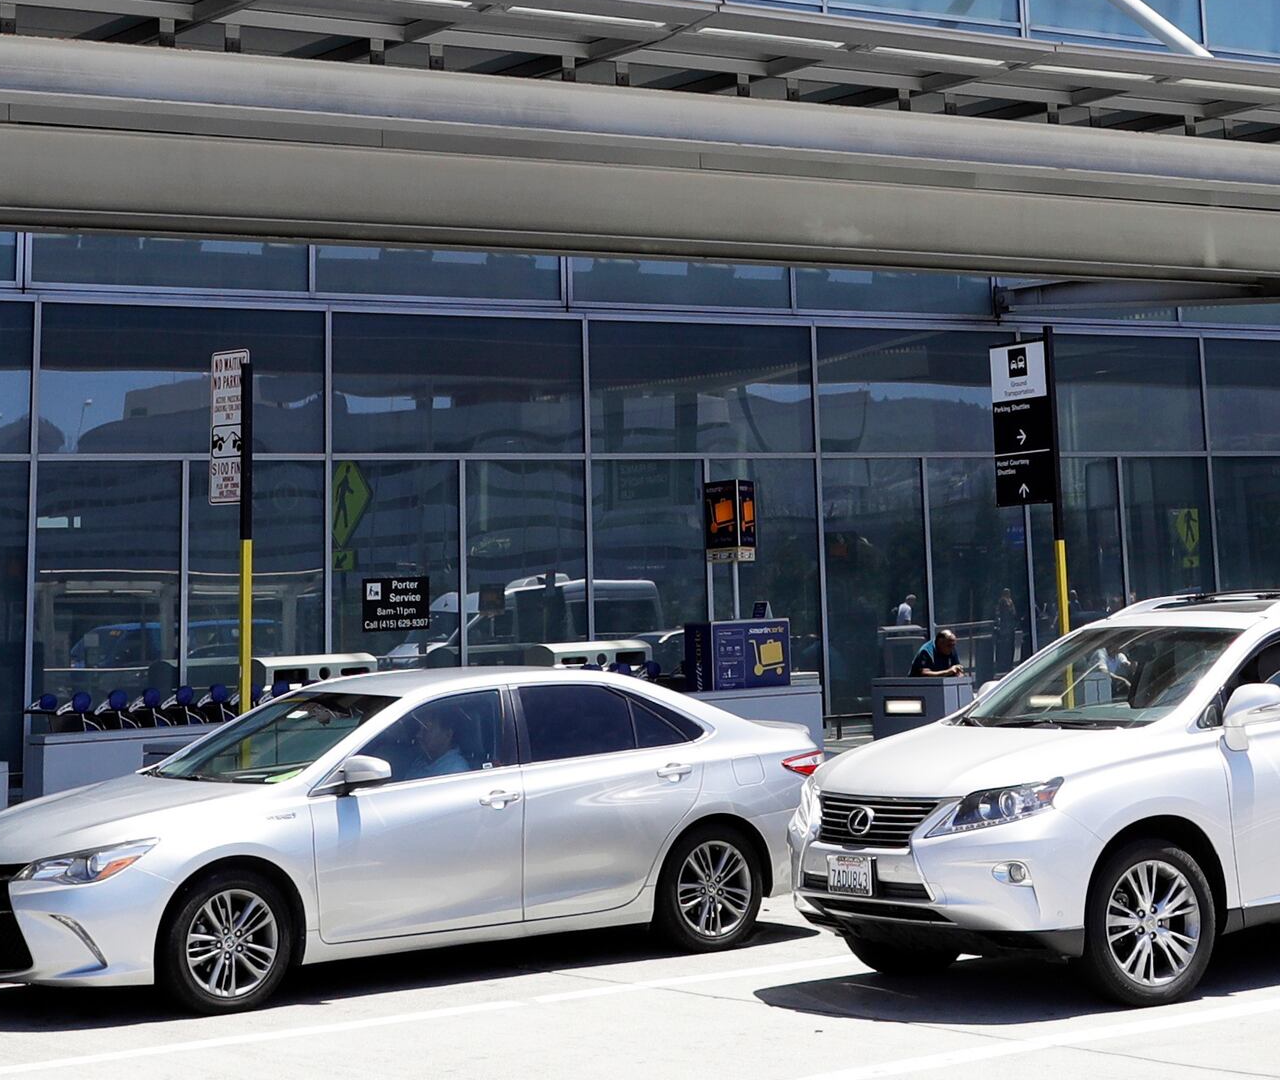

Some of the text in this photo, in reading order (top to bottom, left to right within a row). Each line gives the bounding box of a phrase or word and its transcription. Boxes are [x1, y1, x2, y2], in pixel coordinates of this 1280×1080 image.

[214, 358, 224, 373] NO
[213, 375, 222, 391] NO
[994, 403, 1031, 414] Parking Shuttles
[230, 461, 241, 475] FIN
[391, 580, 419, 590] Porter
[389, 592, 421, 603] Service
[376, 607, 417, 617] 8am-11pm
[364, 620, 378, 629] Call
[379, 619, 397, 629] (415)
[831, 868, 869, 890] 7ADU843
